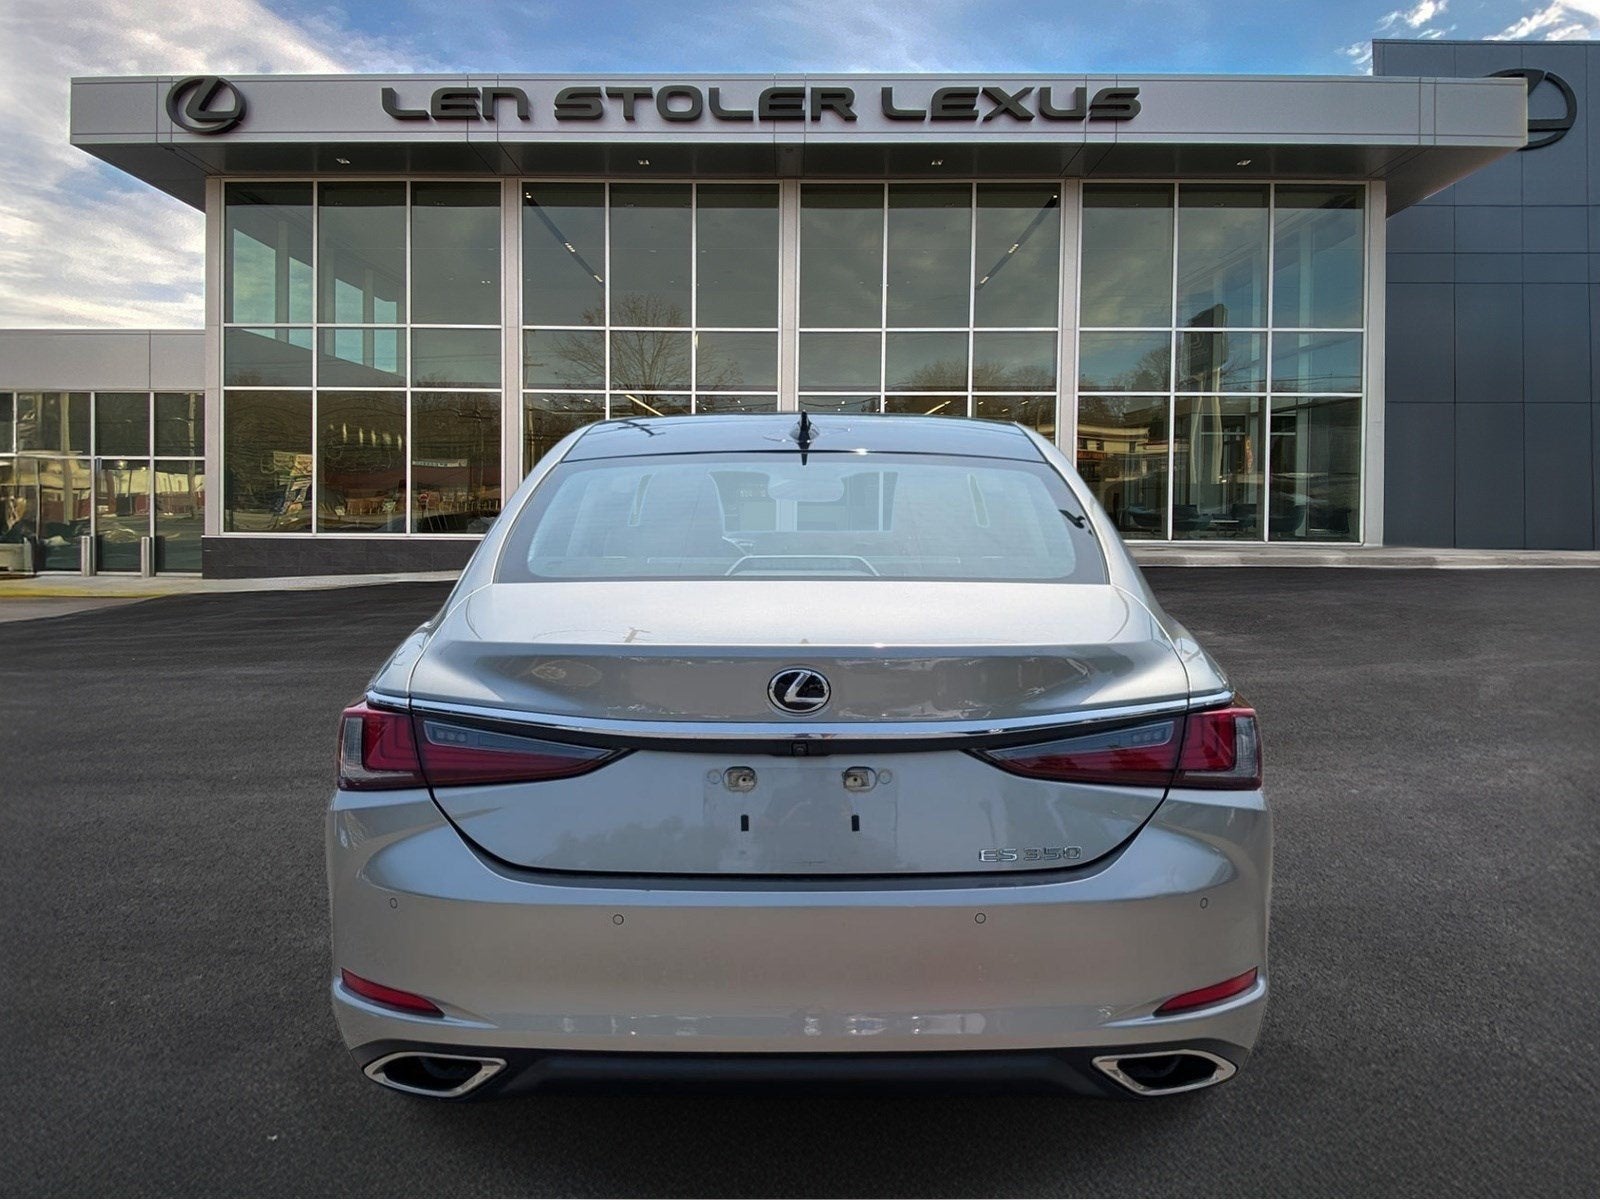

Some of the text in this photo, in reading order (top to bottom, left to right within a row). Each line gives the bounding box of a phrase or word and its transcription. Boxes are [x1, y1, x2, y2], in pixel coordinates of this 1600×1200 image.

[381, 85, 1142, 122] LEN STOLER LEXUS
[979, 846, 1082, 862] ES 350
